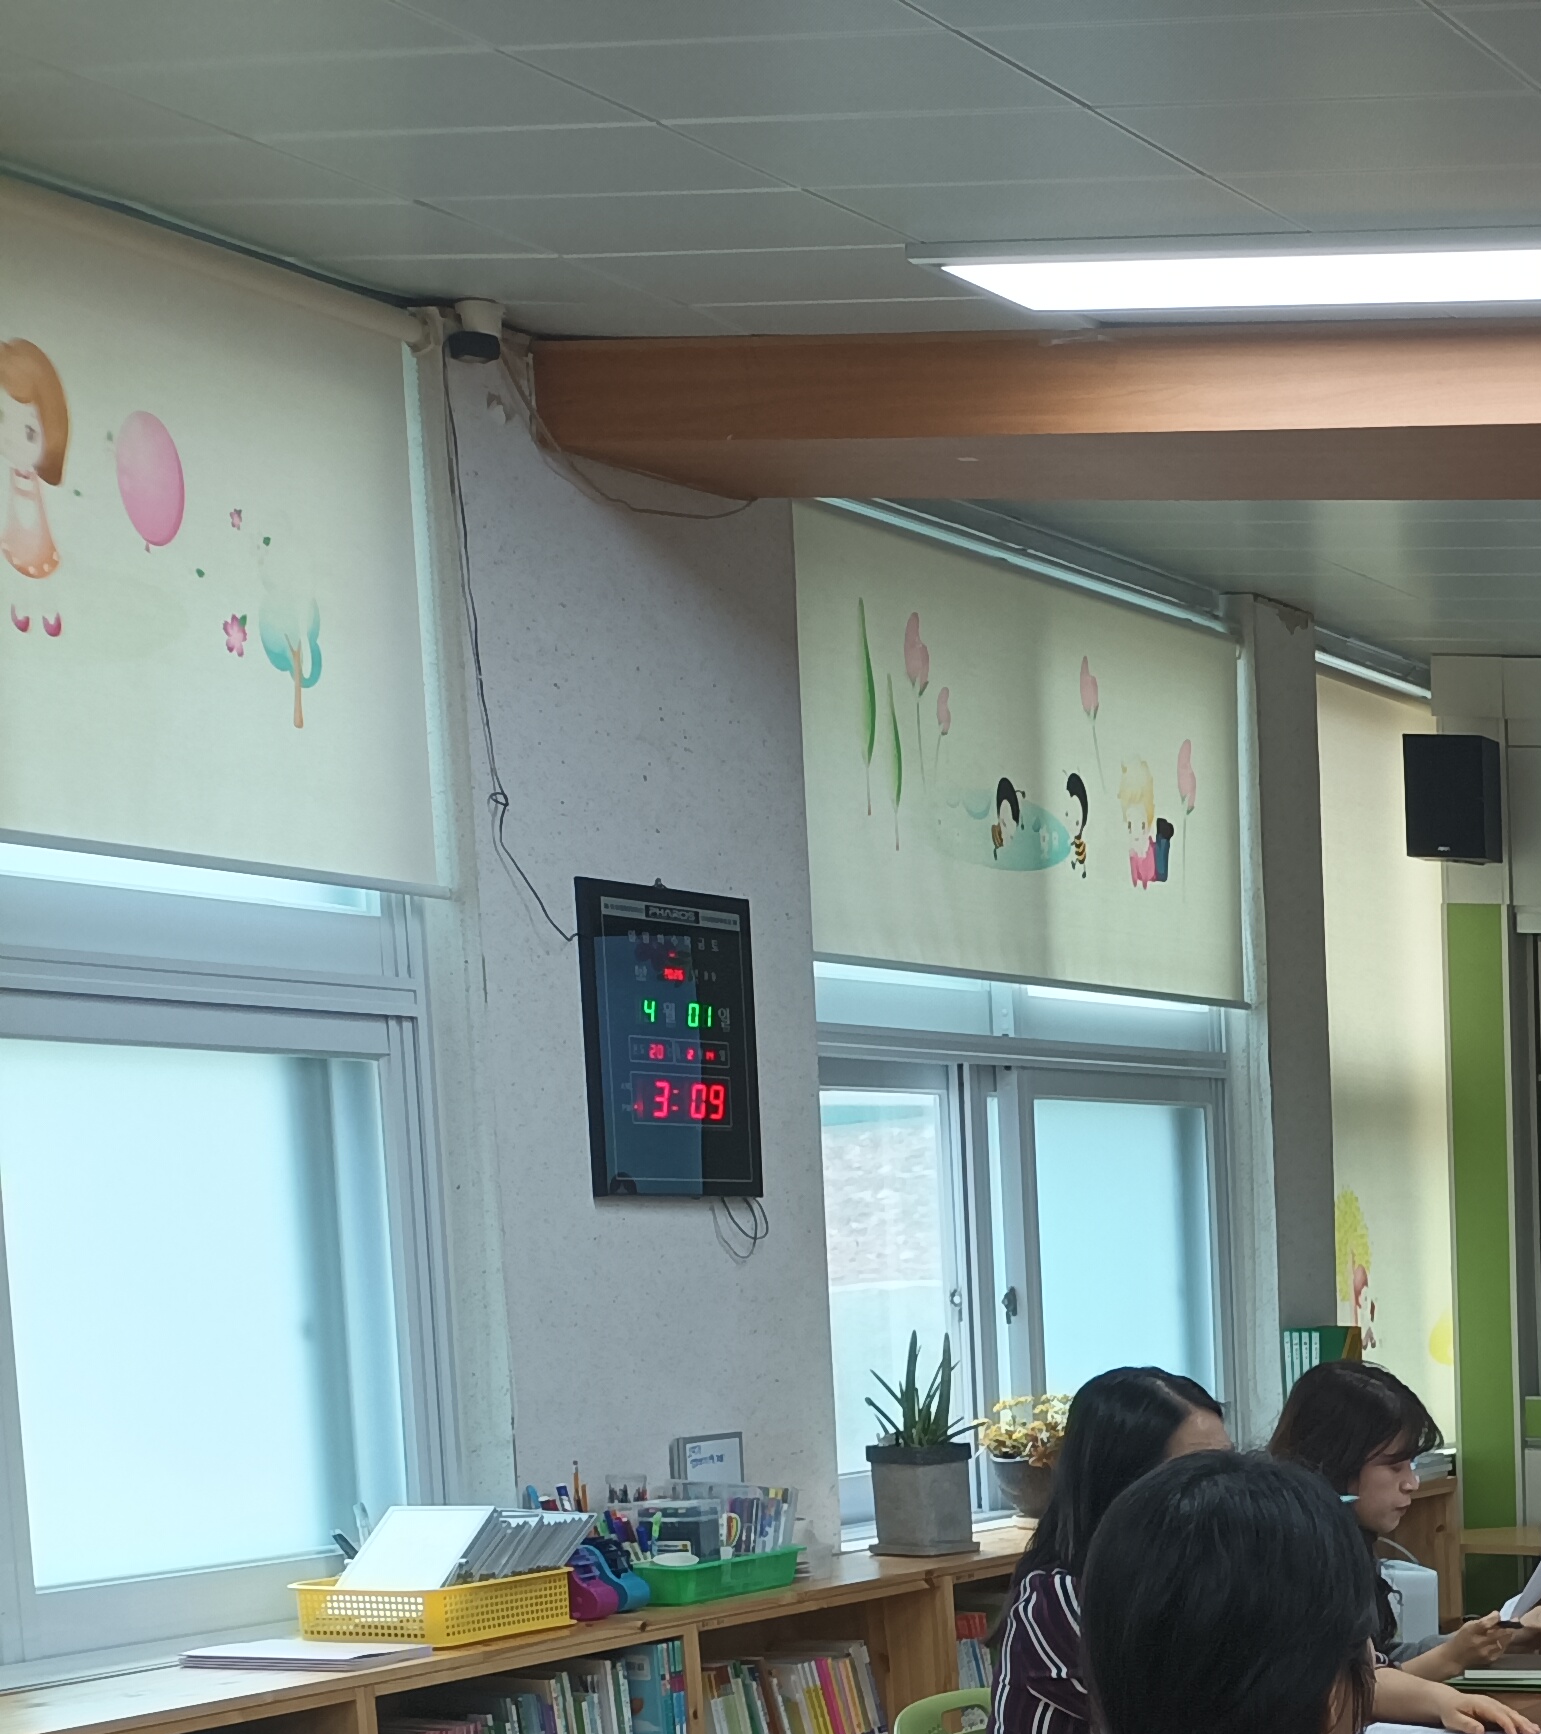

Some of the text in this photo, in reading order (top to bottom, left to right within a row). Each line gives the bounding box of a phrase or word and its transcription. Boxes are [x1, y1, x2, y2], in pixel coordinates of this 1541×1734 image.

[648, 906, 696, 921] PHAROS
[643, 999, 656, 1023] 4
[687, 1003, 712, 1027] 01
[653, 1080, 725, 1120] 3:09
